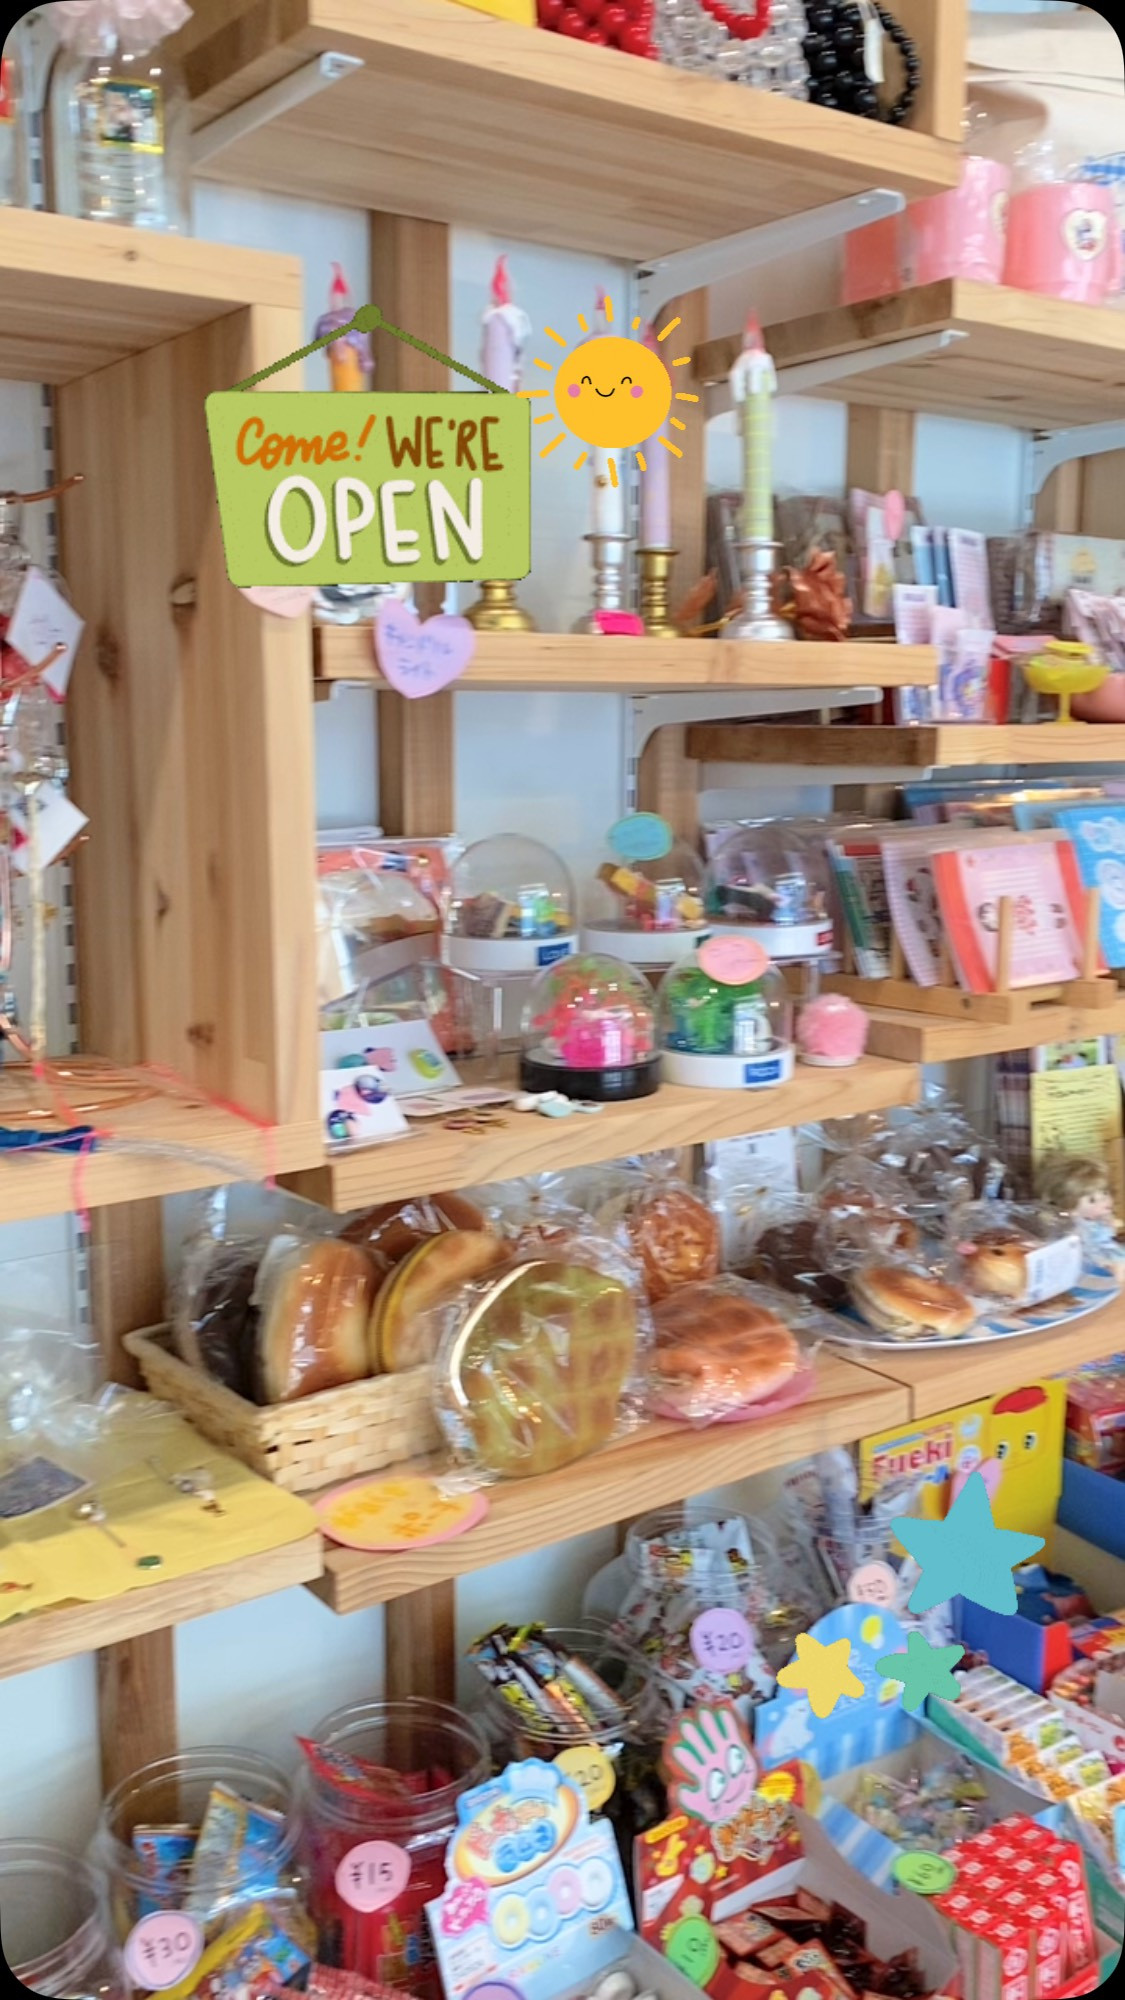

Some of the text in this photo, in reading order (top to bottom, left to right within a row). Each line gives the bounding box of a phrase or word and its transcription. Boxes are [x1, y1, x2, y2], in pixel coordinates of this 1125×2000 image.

[700, 1631, 745, 1657] ¥20
[565, 1764, 604, 1787] 20
[349, 1861, 393, 1890] ¥15
[139, 1930, 193, 1968] ¥30
